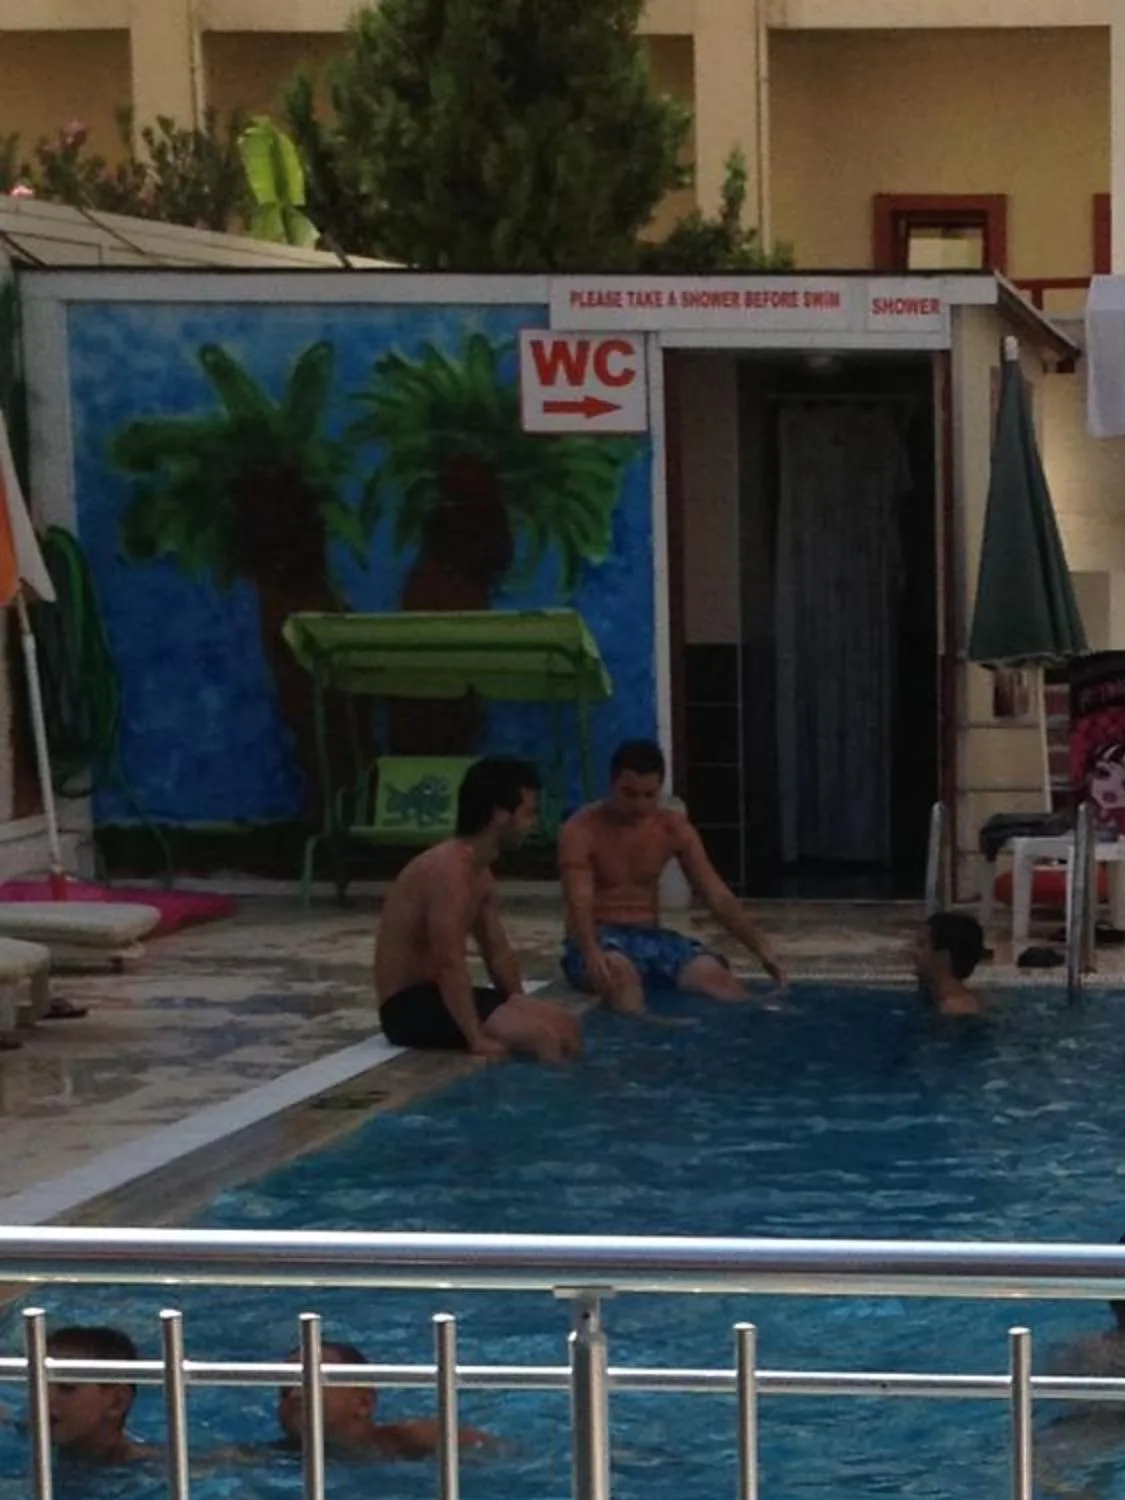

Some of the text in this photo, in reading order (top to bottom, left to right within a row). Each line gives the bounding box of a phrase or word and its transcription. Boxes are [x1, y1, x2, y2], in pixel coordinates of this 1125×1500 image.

[570, 289, 840, 308] PLEASE TAKE A SHOWER BEFORE SWIM
[872, 297, 941, 315] SHOWER
[530, 339, 636, 388] WC
